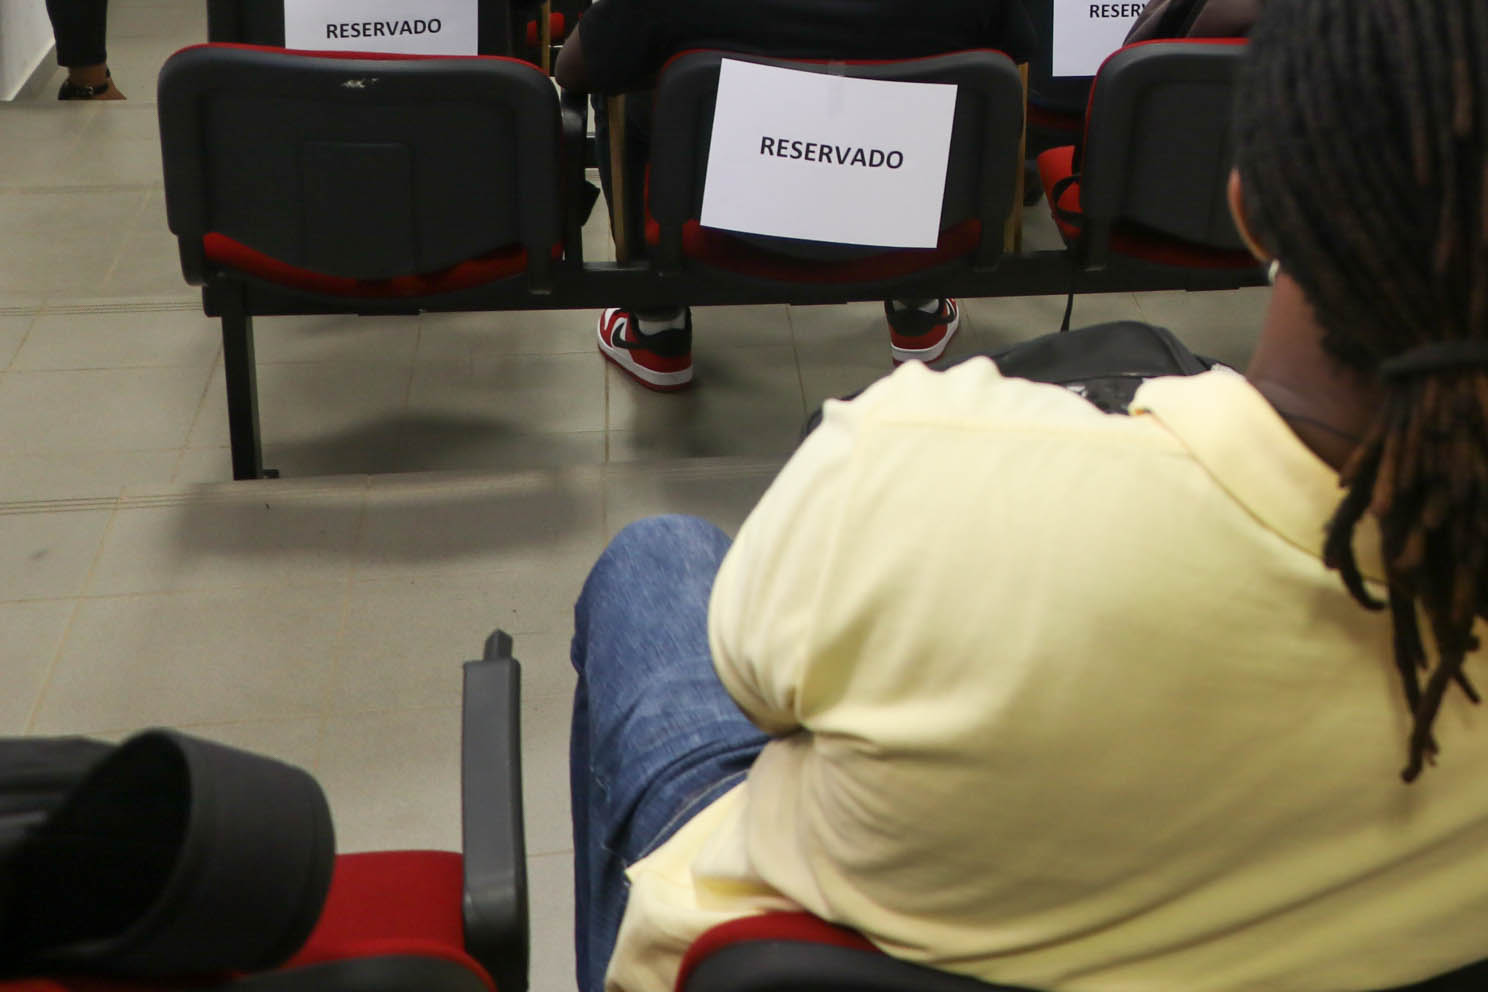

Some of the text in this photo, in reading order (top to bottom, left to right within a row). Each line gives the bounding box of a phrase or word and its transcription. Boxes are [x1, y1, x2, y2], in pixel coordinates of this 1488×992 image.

[1089, 2, 1147, 18] RESER
[326, 18, 442, 39] RESERVADO
[760, 136, 904, 169] RESERVADO
